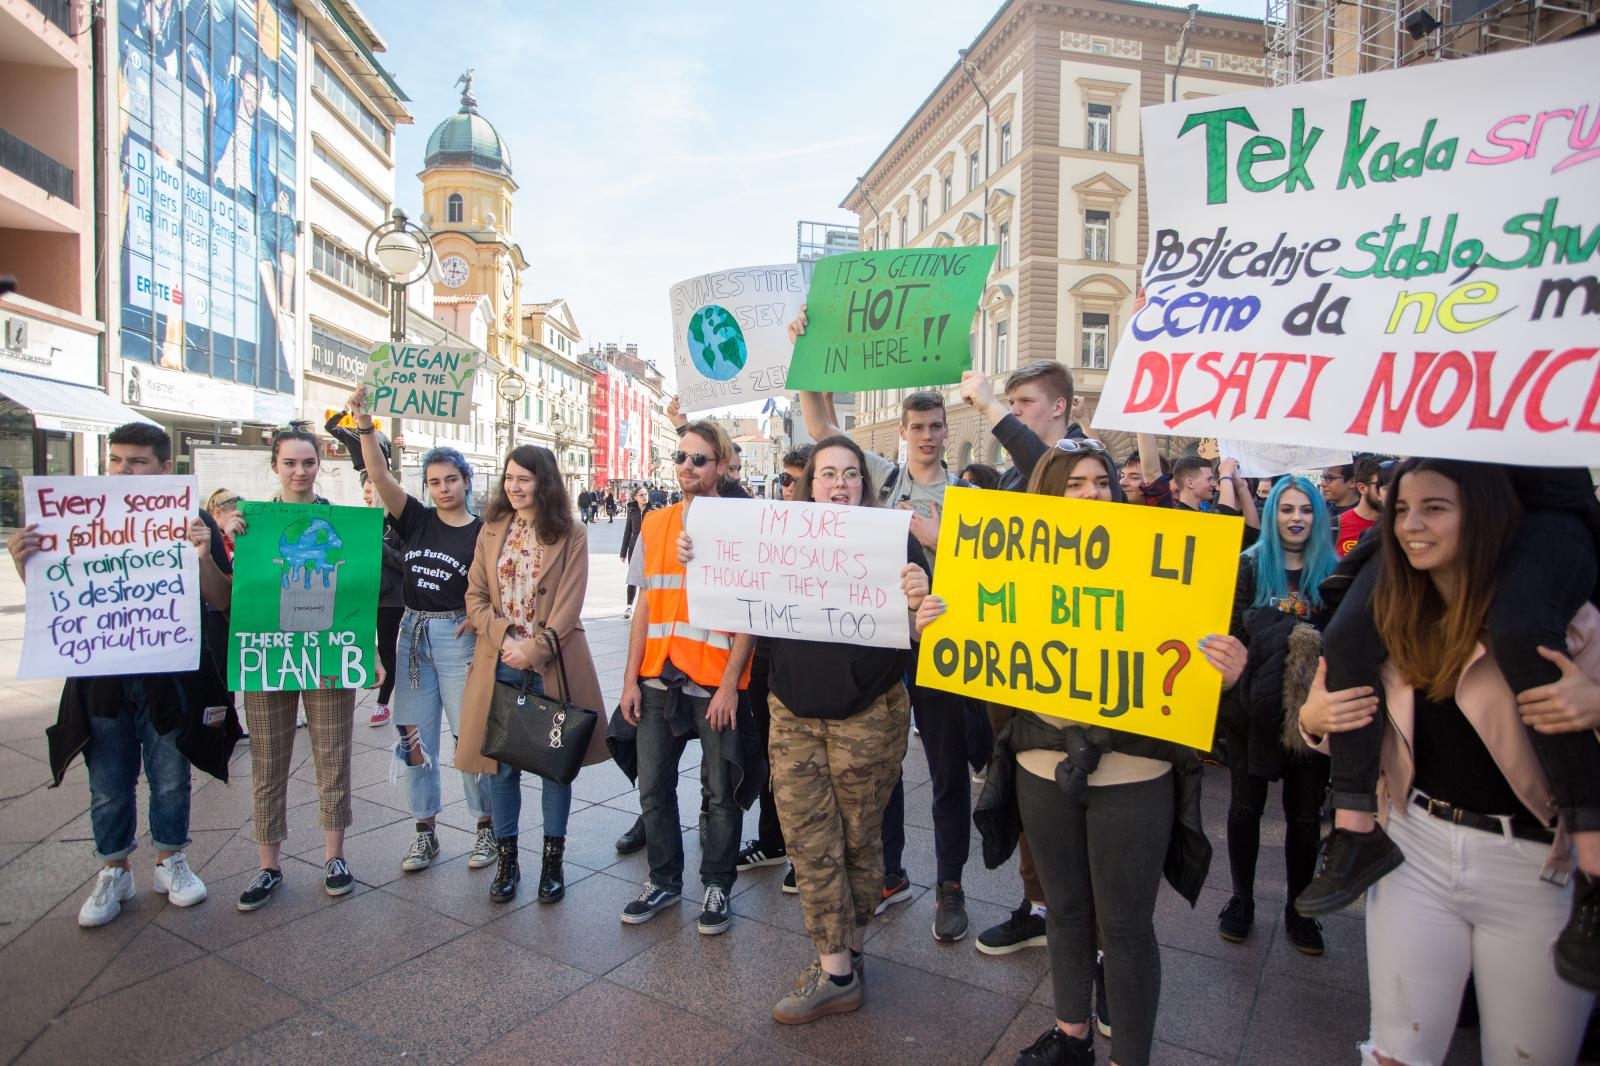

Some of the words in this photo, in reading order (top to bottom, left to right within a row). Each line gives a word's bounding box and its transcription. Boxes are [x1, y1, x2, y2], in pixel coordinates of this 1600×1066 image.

[1177, 106, 1325, 205] Tek
[1336, 98, 1459, 190] kada
[1144, 227, 1342, 289] Posljednje
[1475, 197, 1600, 270] Shv
[834, 257, 877, 286] IT'S
[888, 252, 971, 280] GETTING
[735, 301, 786, 332] SE!
[847, 282, 931, 334] HOT
[1282, 283, 1352, 336] da
[1529, 275, 1600, 322] m
[390, 344, 460, 372] VEGAN
[824, 345, 849, 375] IN
[862, 335, 912, 370] HERE
[390, 371, 416, 385] FOR
[423, 373, 446, 385] THE
[1122, 350, 1336, 430] DISATI
[374, 385, 466, 418] PLANET
[37, 487, 107, 519] Every
[124, 486, 191, 514] second
[760, 504, 789, 537] I'M
[798, 508, 851, 540] SURE
[38, 533, 58, 553] a
[142, 517, 190, 548] field
[954, 513, 1111, 571] MORAMO
[1150, 532, 1197, 586] LI
[46, 556, 75, 587] of
[84, 542, 187, 581] rainforest
[411, 564, 453, 581] cruelty
[423, 548, 460, 568] future
[458, 564, 468, 576] is
[715, 539, 743, 563] THE
[758, 542, 869, 580] DINOSAURS
[50, 591, 70, 612] is
[78, 573, 186, 609] destroyed
[416, 578, 441, 591] free
[700, 565, 771, 593] THOUGHT
[781, 573, 830, 601] THEY
[849, 583, 887, 610] HAD
[48, 615, 88, 646] for
[96, 598, 181, 631] animal
[736, 598, 802, 634] TIME
[821, 607, 877, 641] TOO
[977, 582, 1017, 624] MI
[1050, 584, 1124, 632] BITI
[58, 626, 194, 665] agriculture.
[235, 631, 295, 649] THERE
[303, 631, 319, 648] IS
[328, 631, 356, 649] NO
[341, 646, 368, 689] B
[932, 636, 1145, 718] ODRASLIJI
